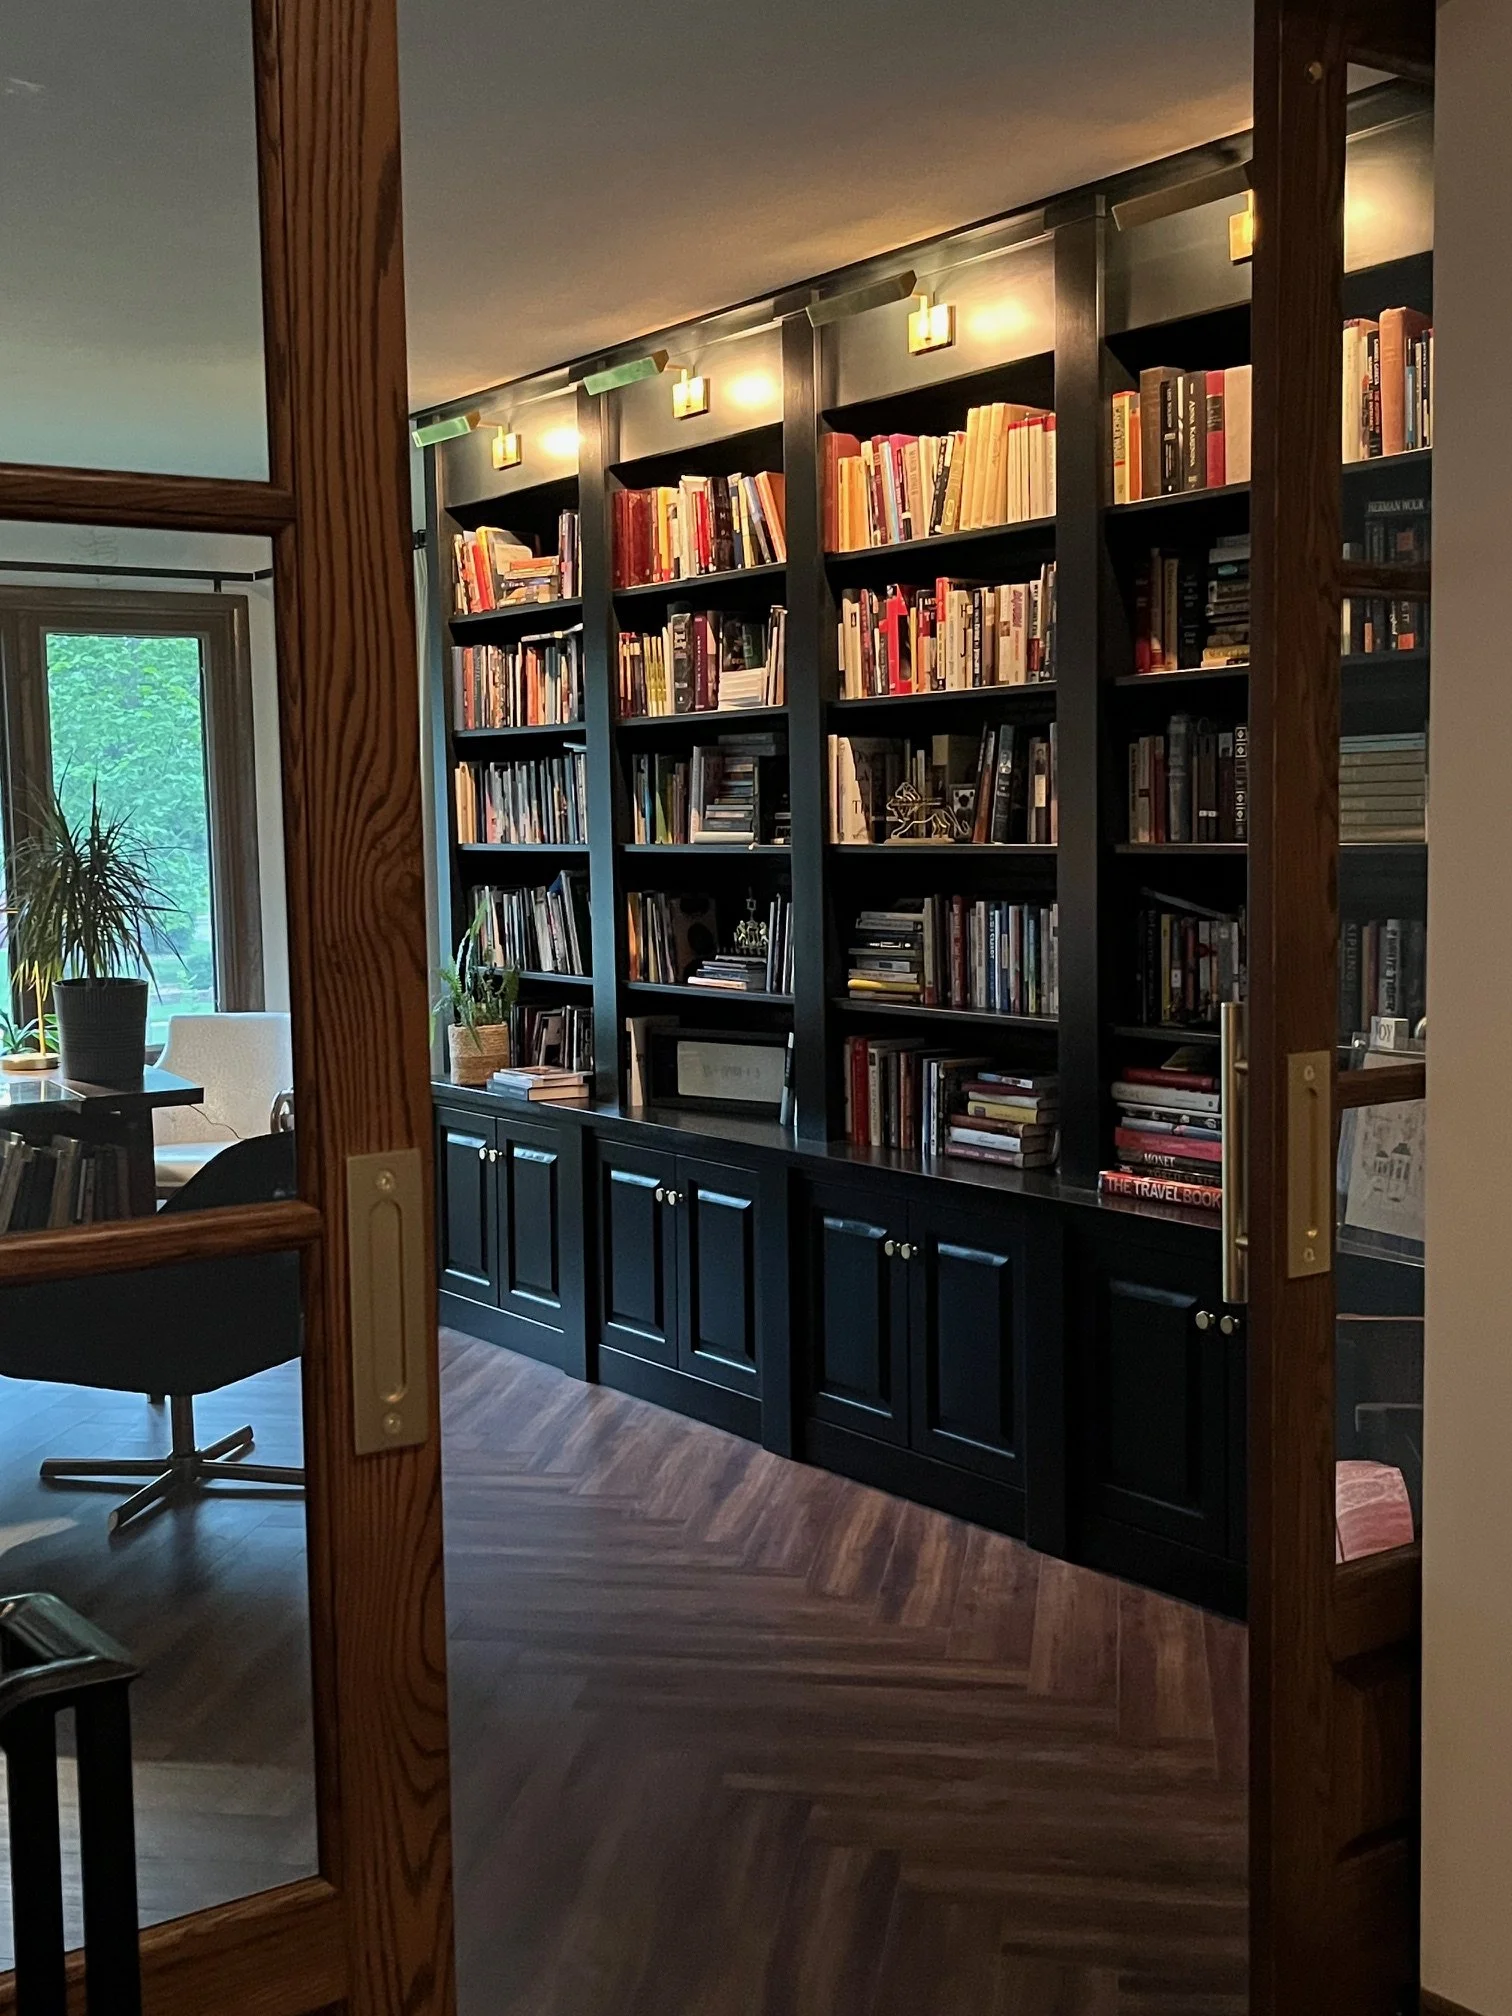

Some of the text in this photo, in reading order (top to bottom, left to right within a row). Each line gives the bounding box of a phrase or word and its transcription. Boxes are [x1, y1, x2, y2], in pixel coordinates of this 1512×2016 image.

[1346, 923, 1356, 982] KIPLING
[1143, 1152, 1176, 1168] MONET
[1106, 1177, 1221, 1209] THE TRAVEL BOOK
